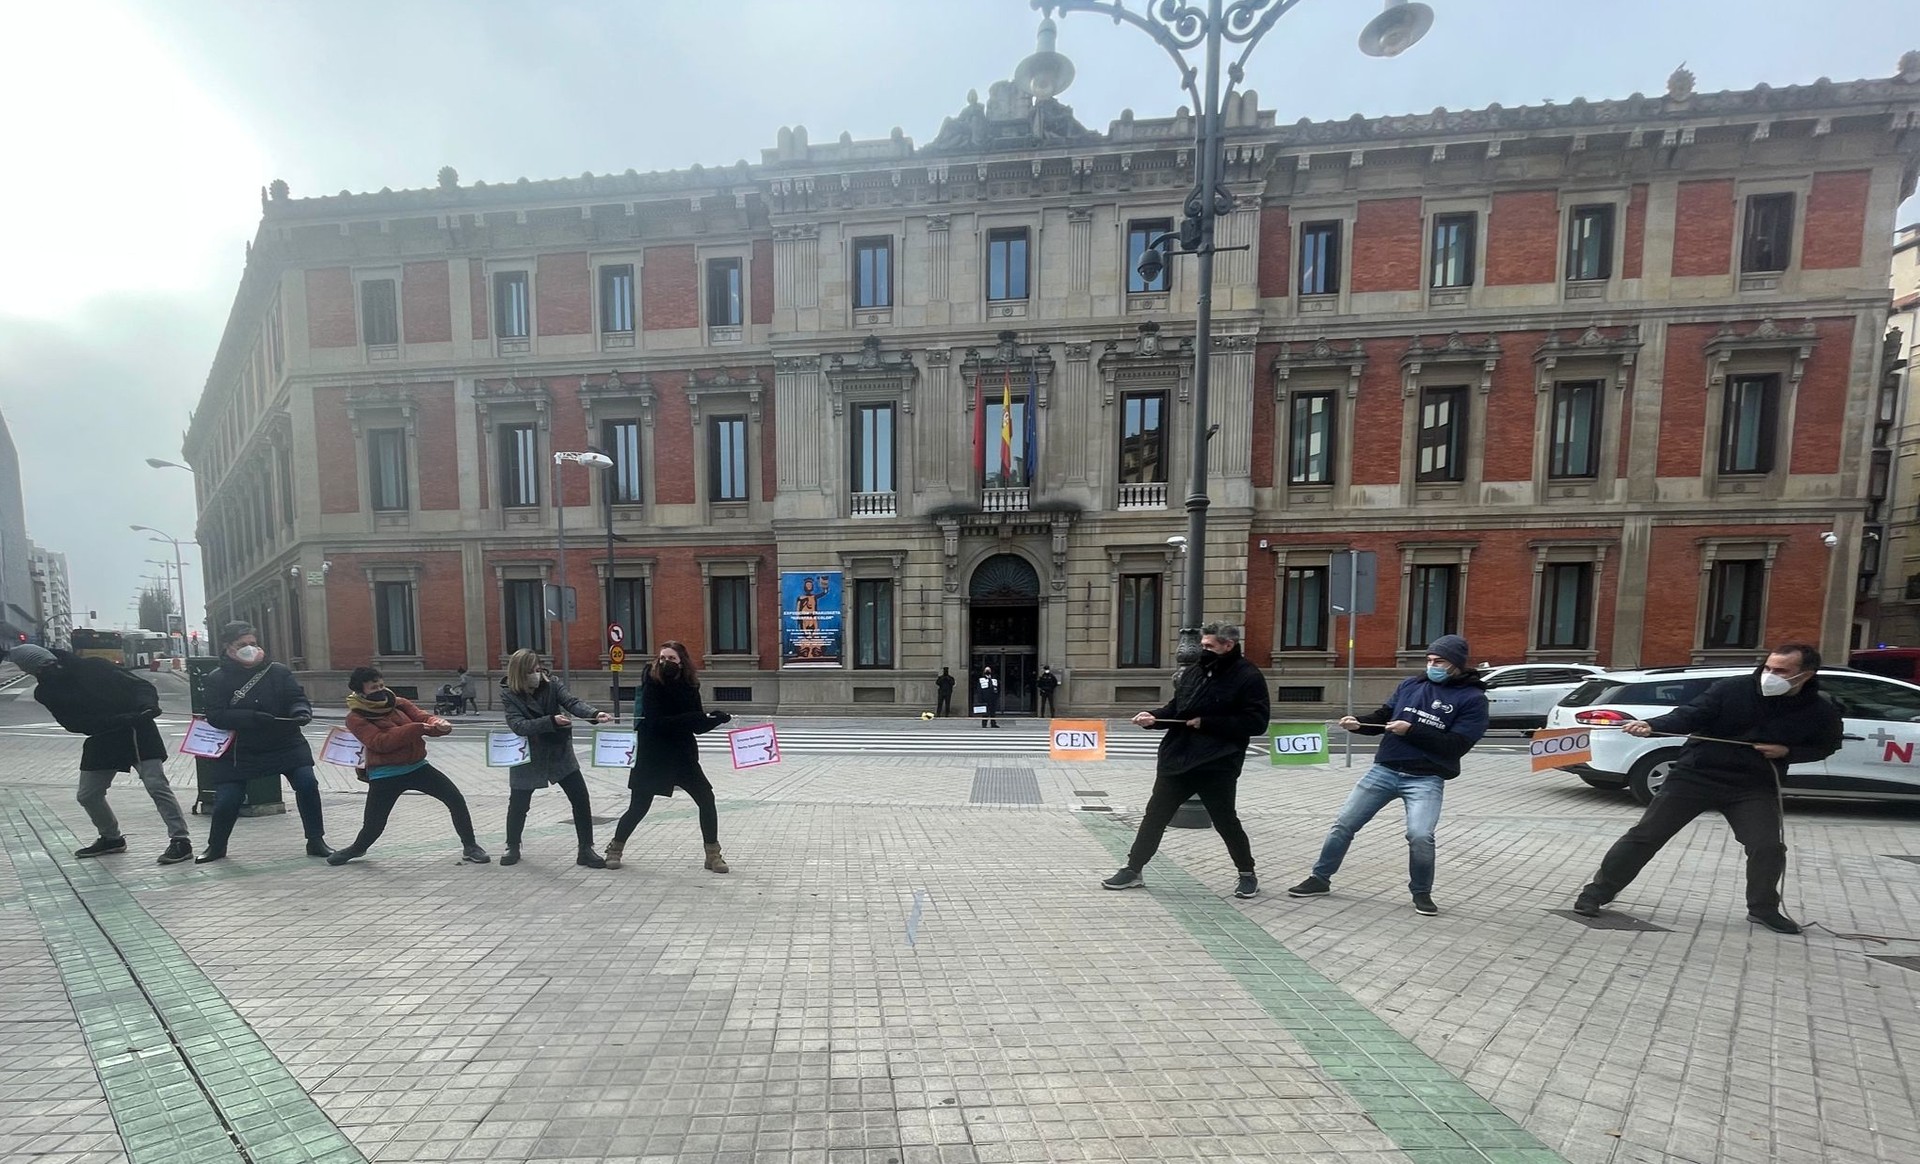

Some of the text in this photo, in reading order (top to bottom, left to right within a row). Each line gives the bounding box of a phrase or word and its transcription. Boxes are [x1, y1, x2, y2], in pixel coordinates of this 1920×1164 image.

[1055, 732, 1096, 748] CEN
[1276, 736, 1320, 752] UGT
[1530, 733, 1590, 756] CCOO
